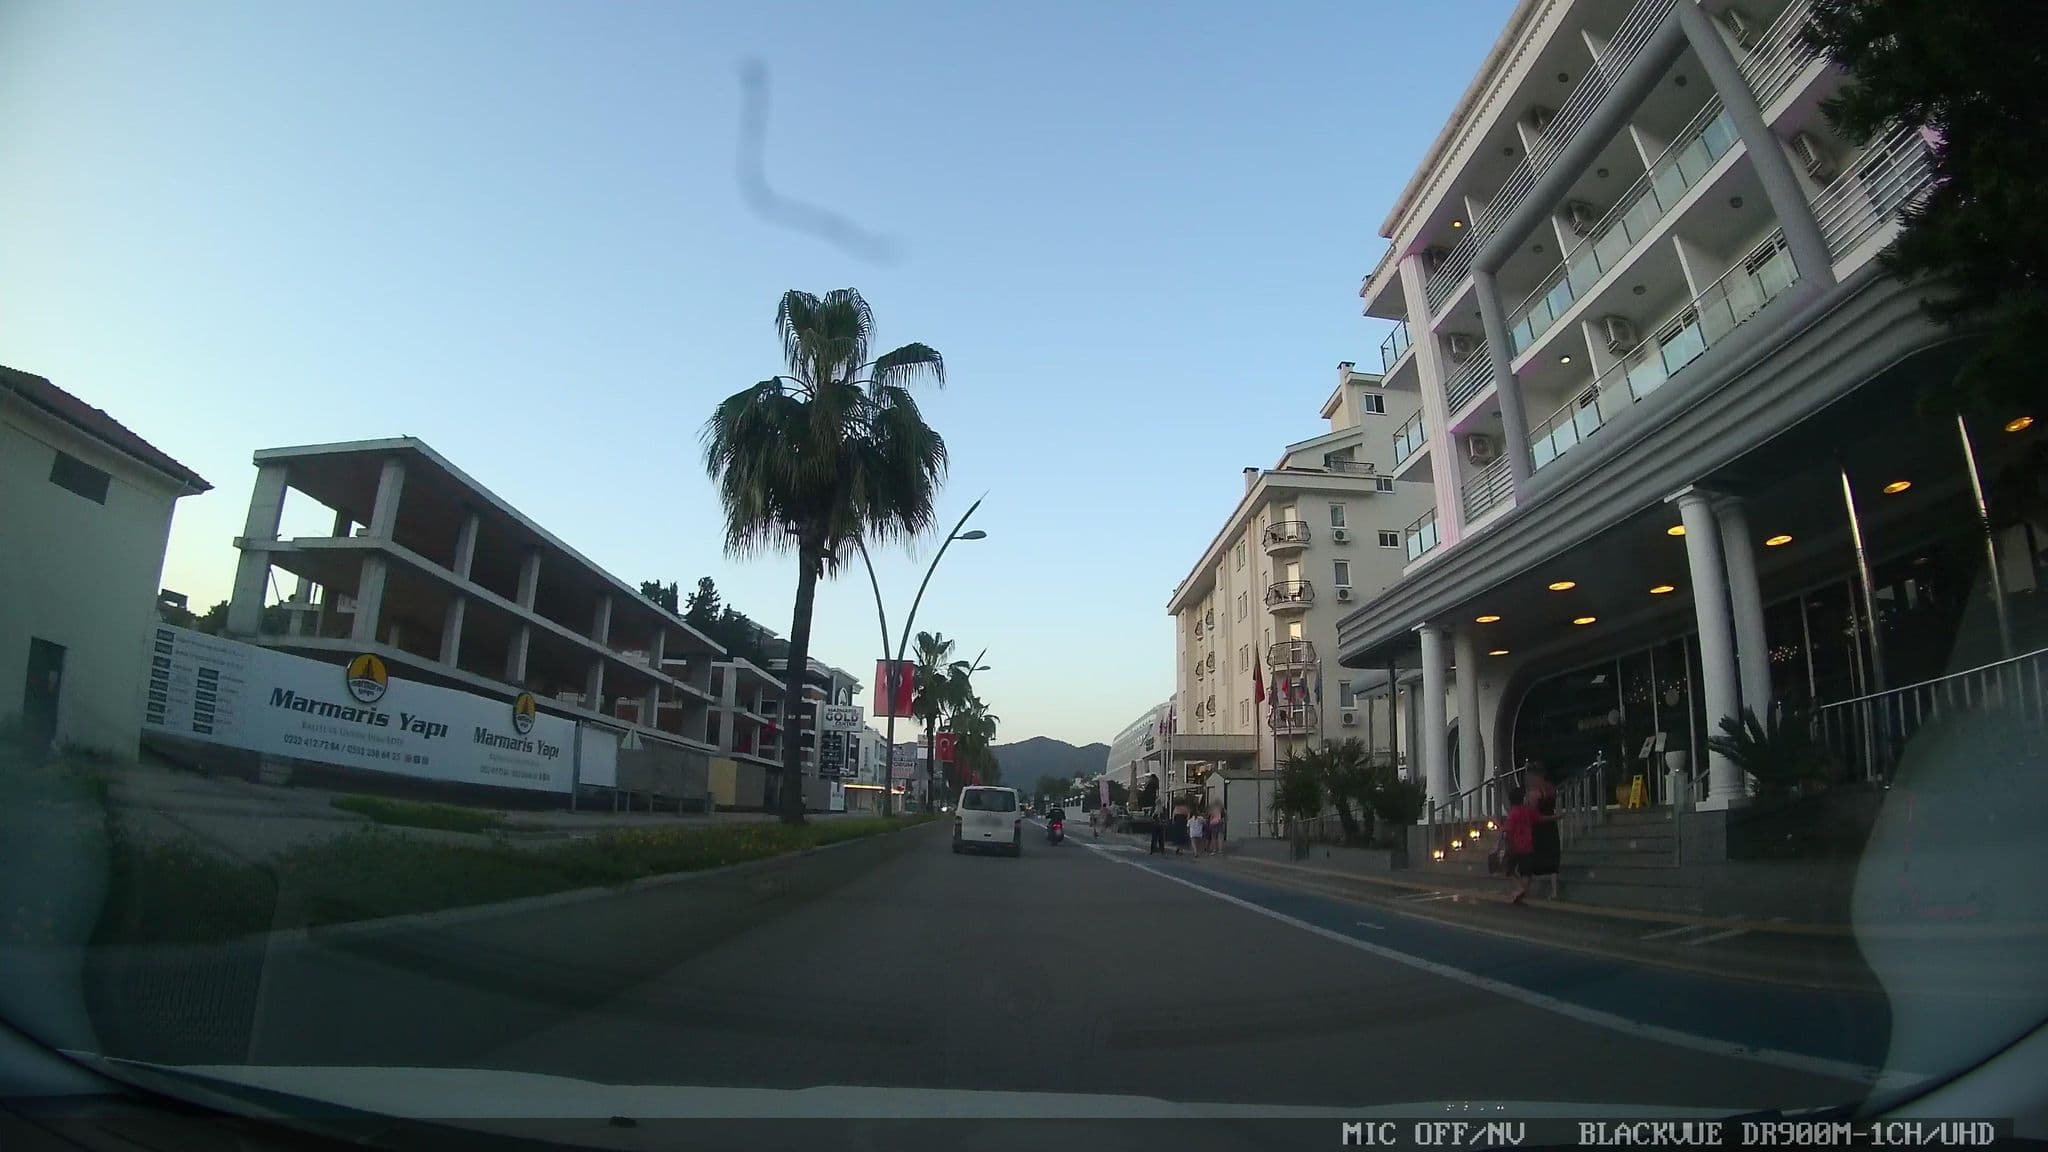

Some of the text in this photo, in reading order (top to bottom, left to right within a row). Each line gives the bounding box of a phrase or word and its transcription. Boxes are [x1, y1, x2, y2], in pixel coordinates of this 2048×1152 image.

[269, 687, 390, 727] Marmaris
[400, 712, 448, 739] Yapı
[826, 712, 858, 722] GOLD
[473, 726, 533, 753] Marmaris
[537, 740, 559, 760] Yapı
